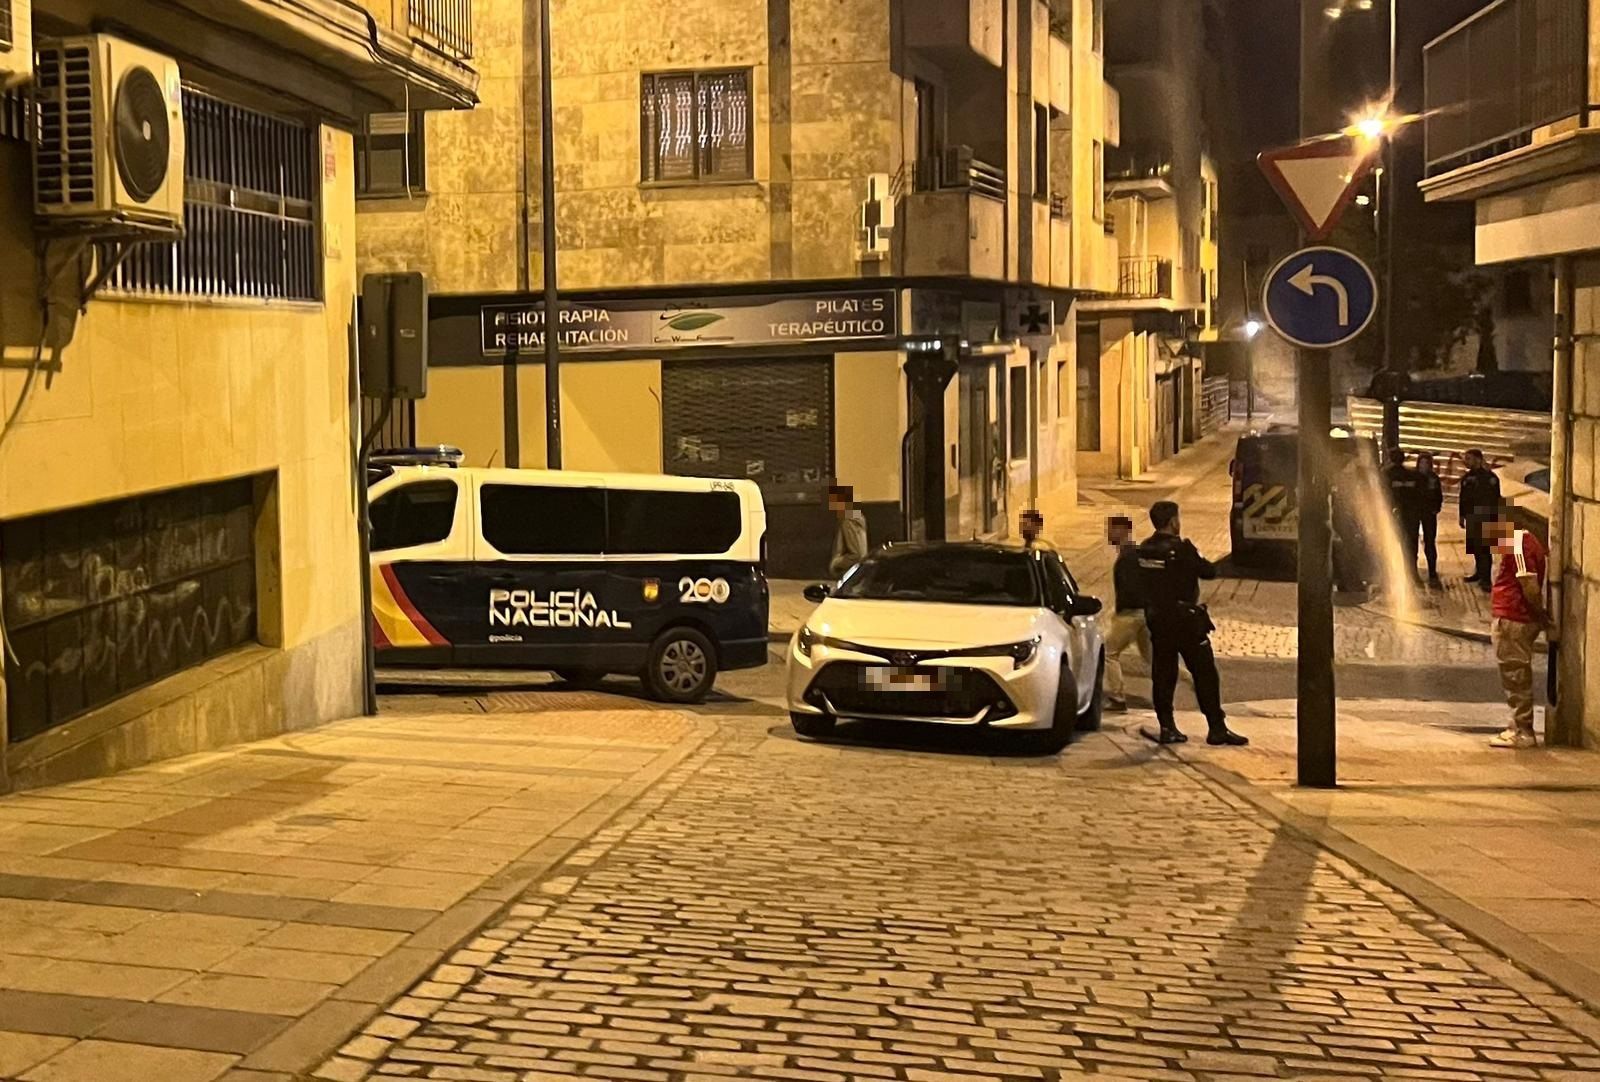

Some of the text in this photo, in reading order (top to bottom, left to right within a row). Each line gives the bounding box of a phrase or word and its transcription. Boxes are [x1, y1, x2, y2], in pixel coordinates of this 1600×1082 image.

[816, 298, 884, 313] PILATES
[495, 309, 610, 326] FISIOTRAPIA
[768, 319, 885, 337] TERAPÉUTICO
[495, 326, 629, 347] REHALITACIÓN
[490, 588, 598, 610] POLICÍA
[678, 576, 730, 604] 200
[489, 607, 632, 629] NACIONAL
